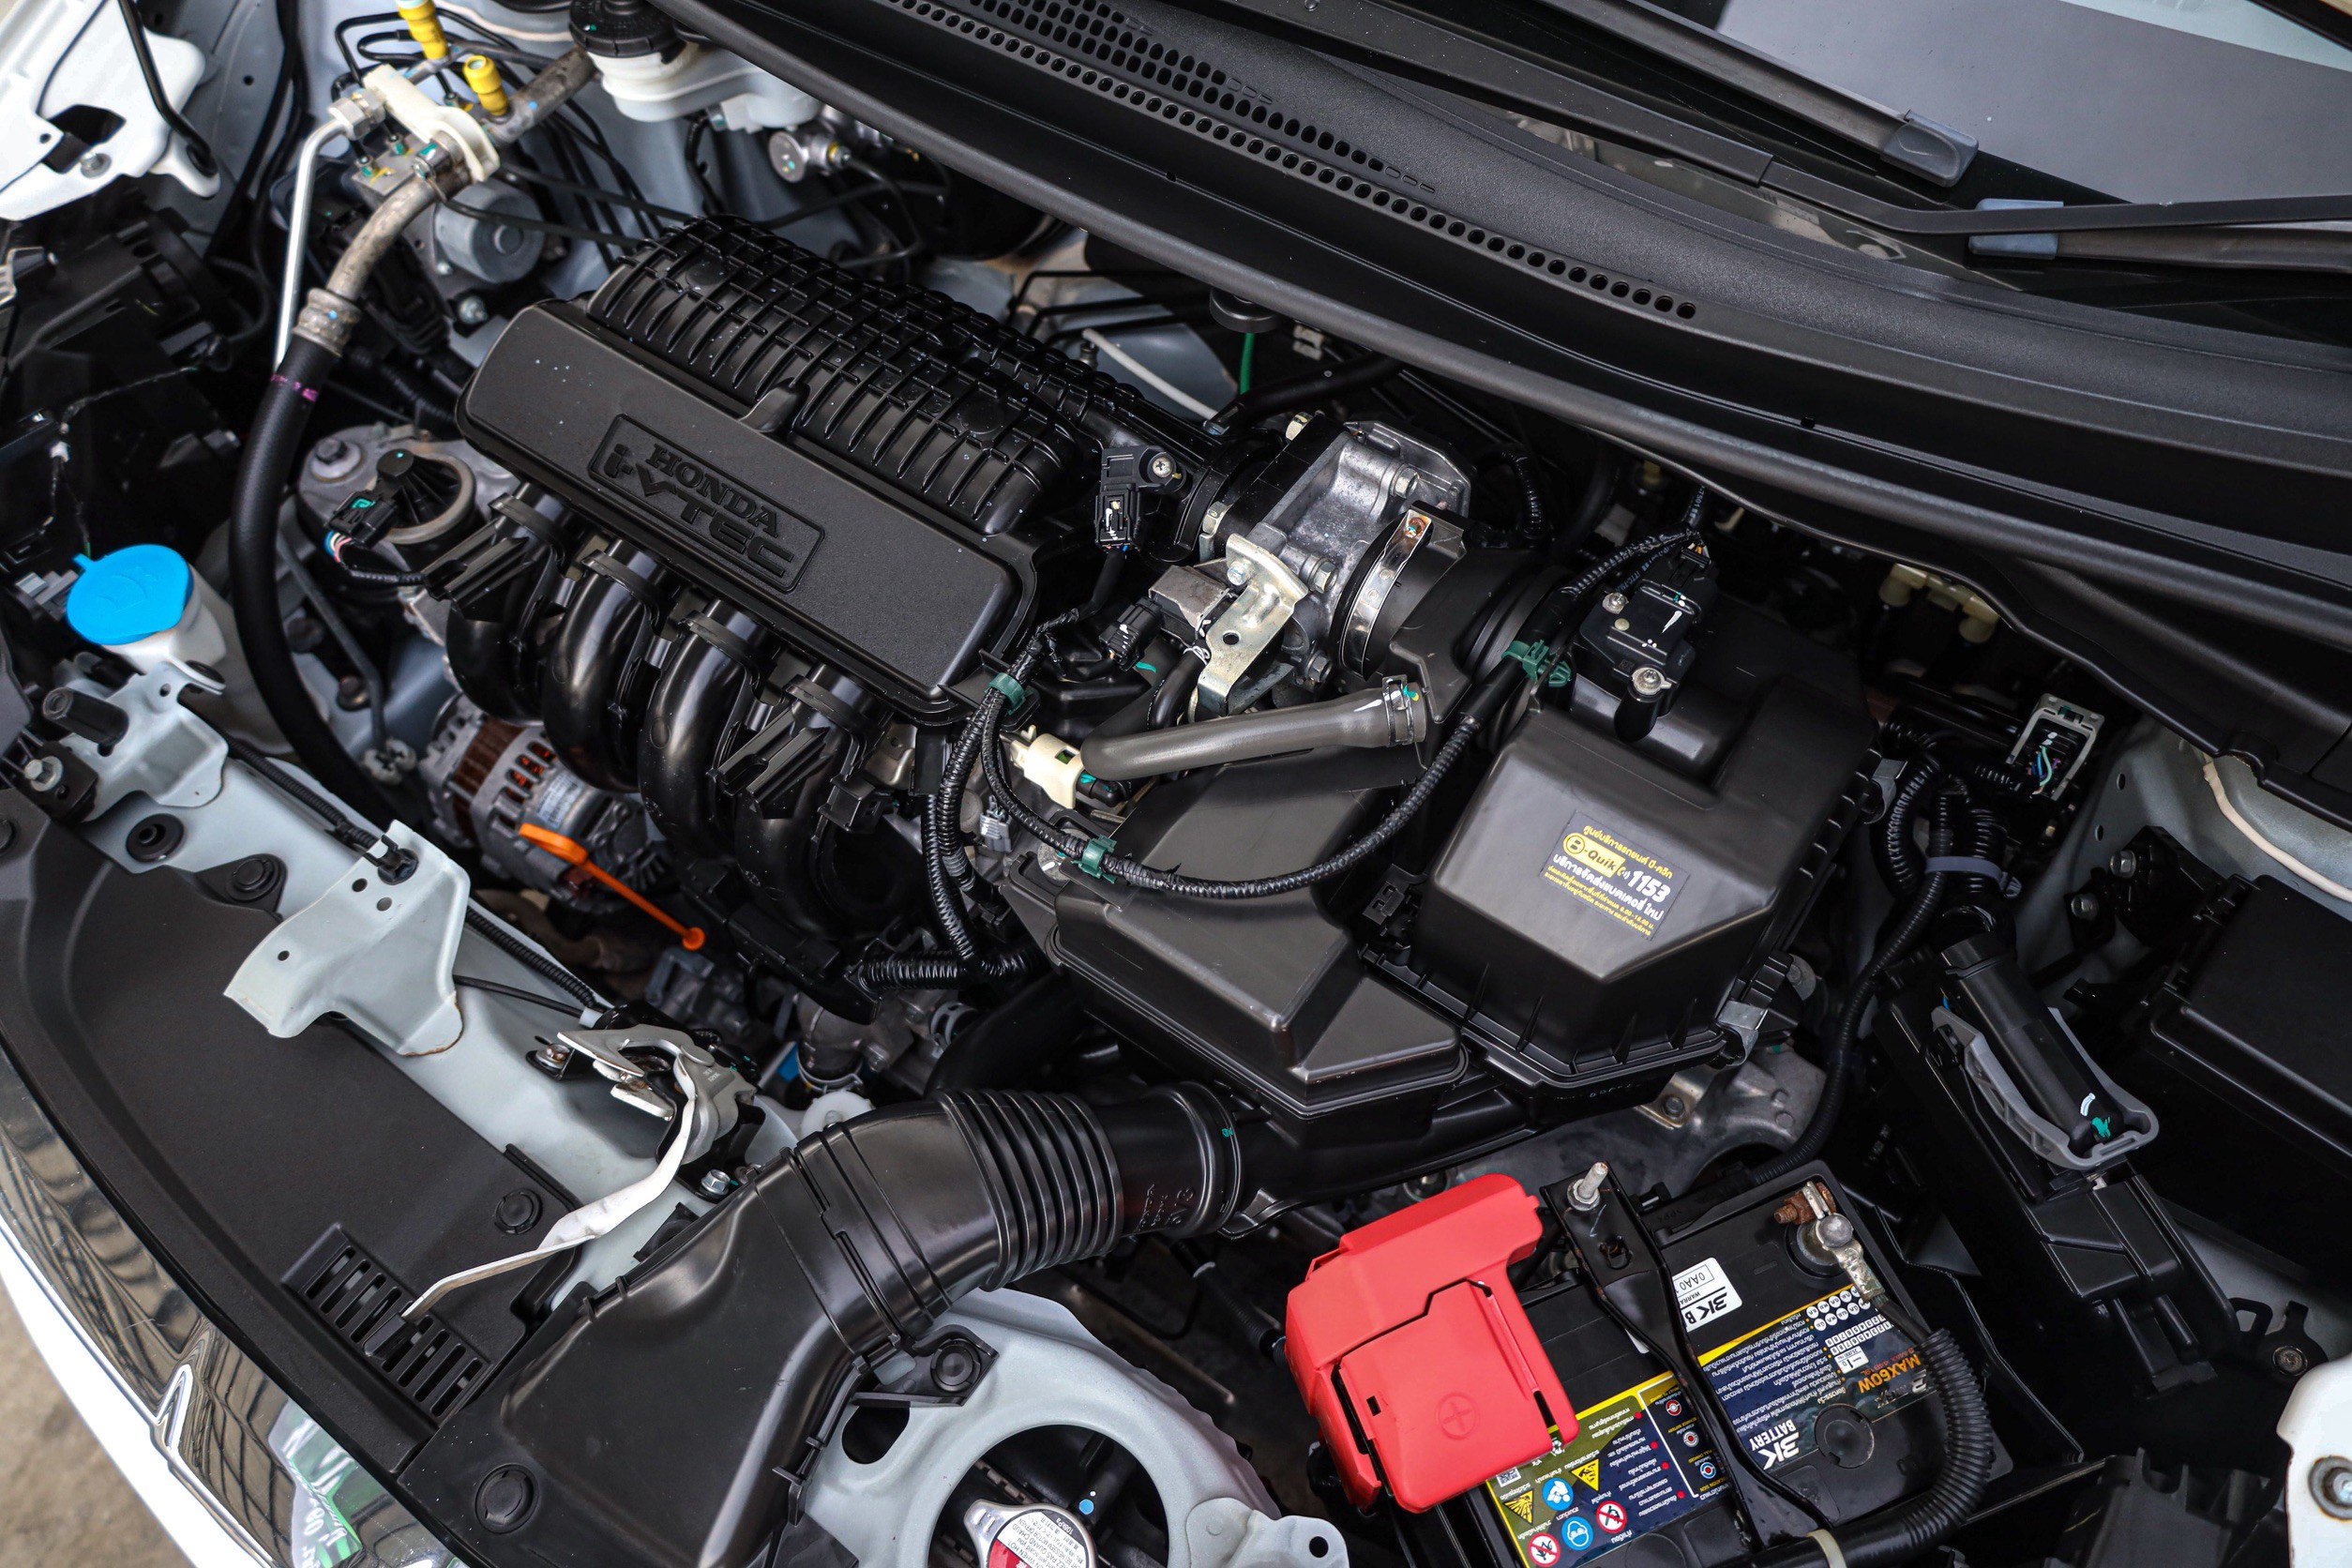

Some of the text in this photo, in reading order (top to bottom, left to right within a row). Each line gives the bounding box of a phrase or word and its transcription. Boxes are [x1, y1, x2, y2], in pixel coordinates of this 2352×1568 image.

[599, 441, 799, 578] i-VTEC
[643, 442, 787, 538] HONDA
[1569, 837, 1672, 905] B-Quik 1153
[1678, 1291, 1700, 1305] WARRA
[1694, 1291, 1732, 1319] 3K
[1855, 1352, 1922, 1394] MAX60W
[1747, 1418, 1797, 1451] BATTERY
[1755, 1431, 1806, 1470] 3K
